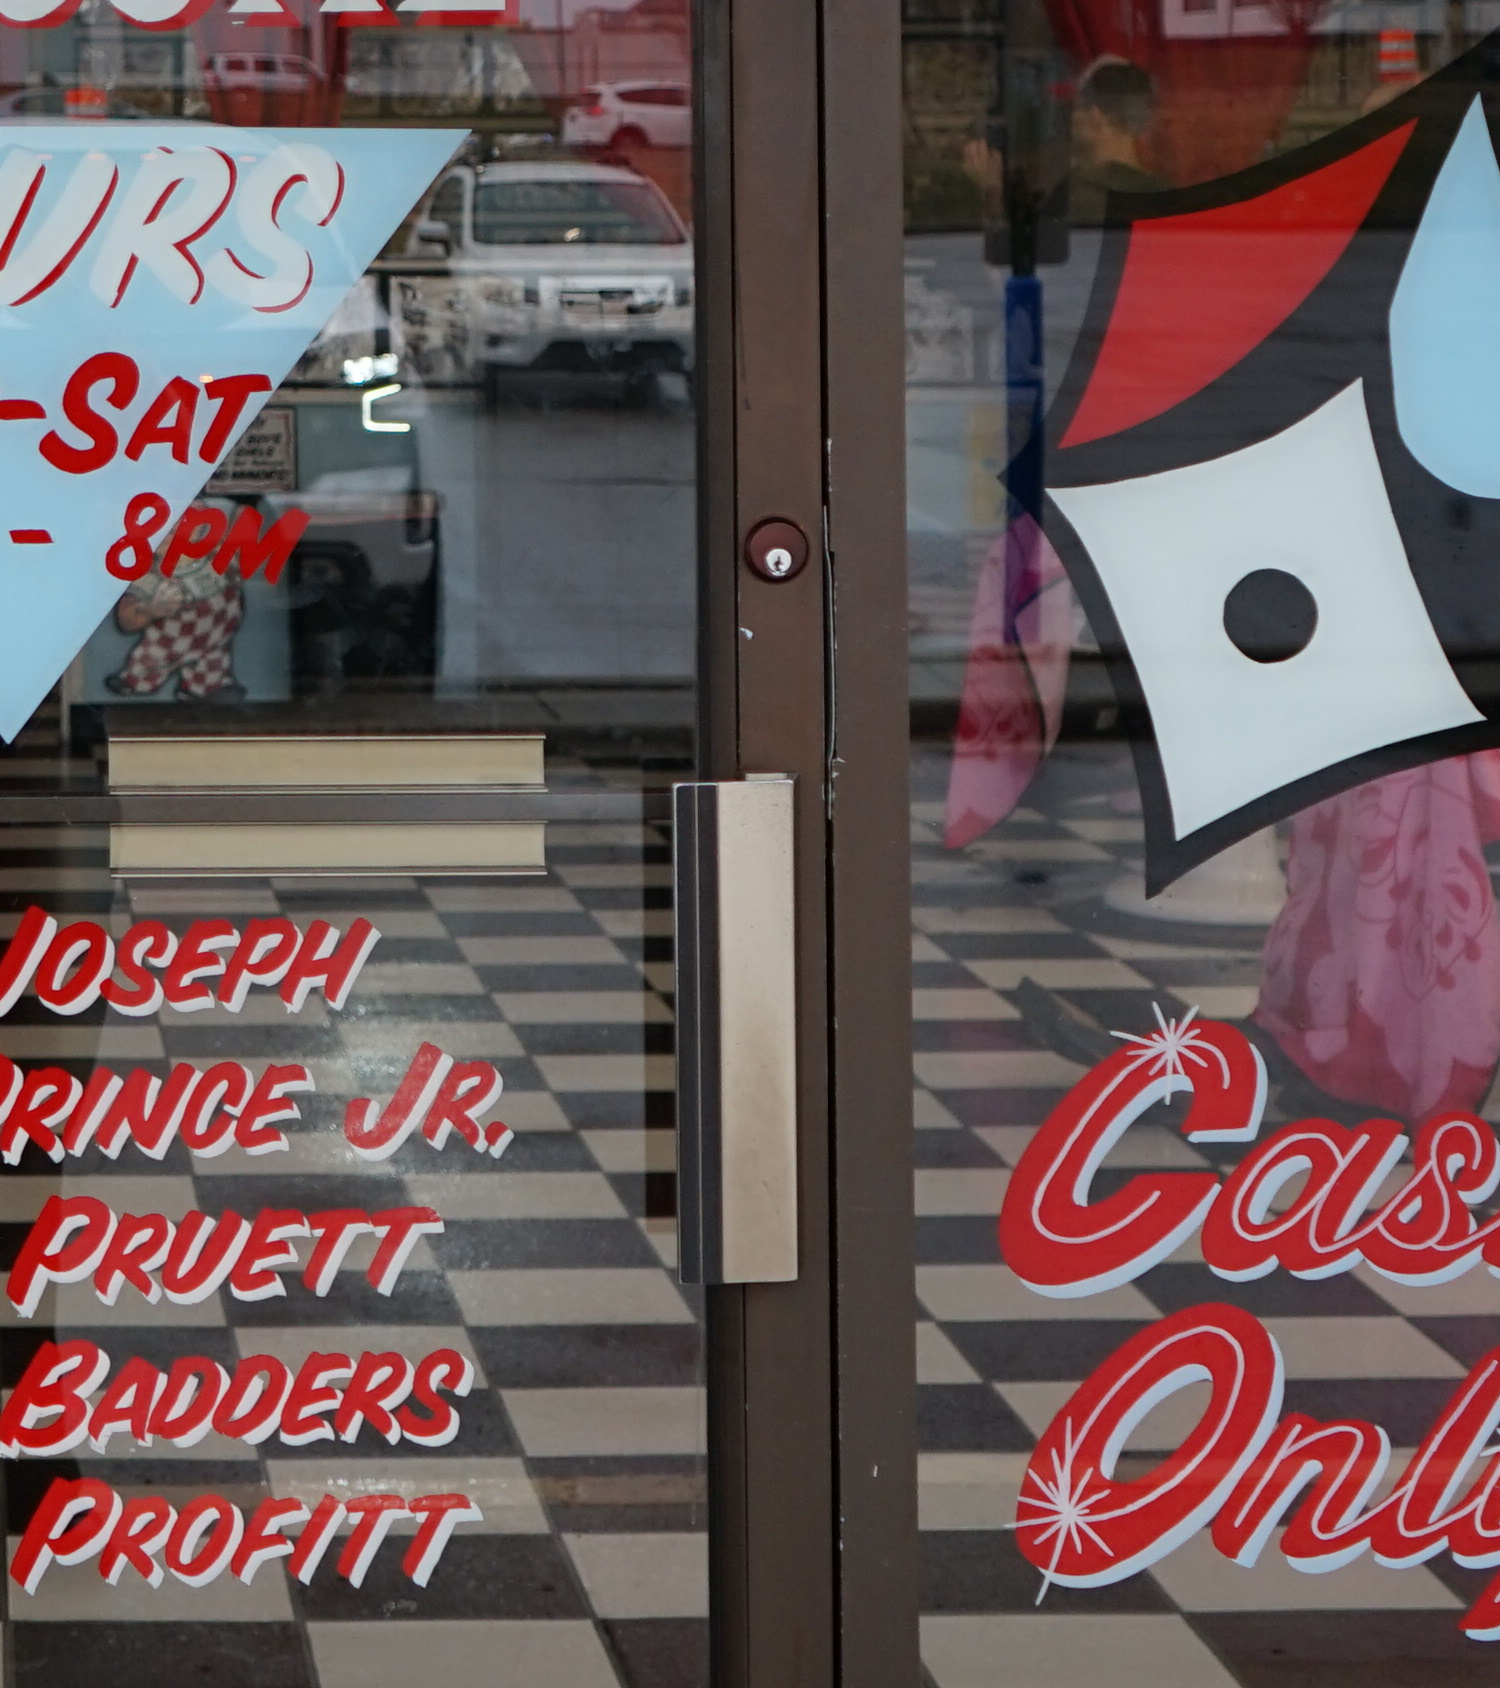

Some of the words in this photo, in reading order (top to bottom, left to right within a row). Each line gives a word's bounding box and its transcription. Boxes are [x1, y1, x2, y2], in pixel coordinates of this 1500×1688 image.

[105, 491, 310, 585] 8PM
[344, 1041, 515, 1159] JR.
[6, 1196, 444, 1320] PRUETT
[8, 1477, 485, 1596] PROFITT
